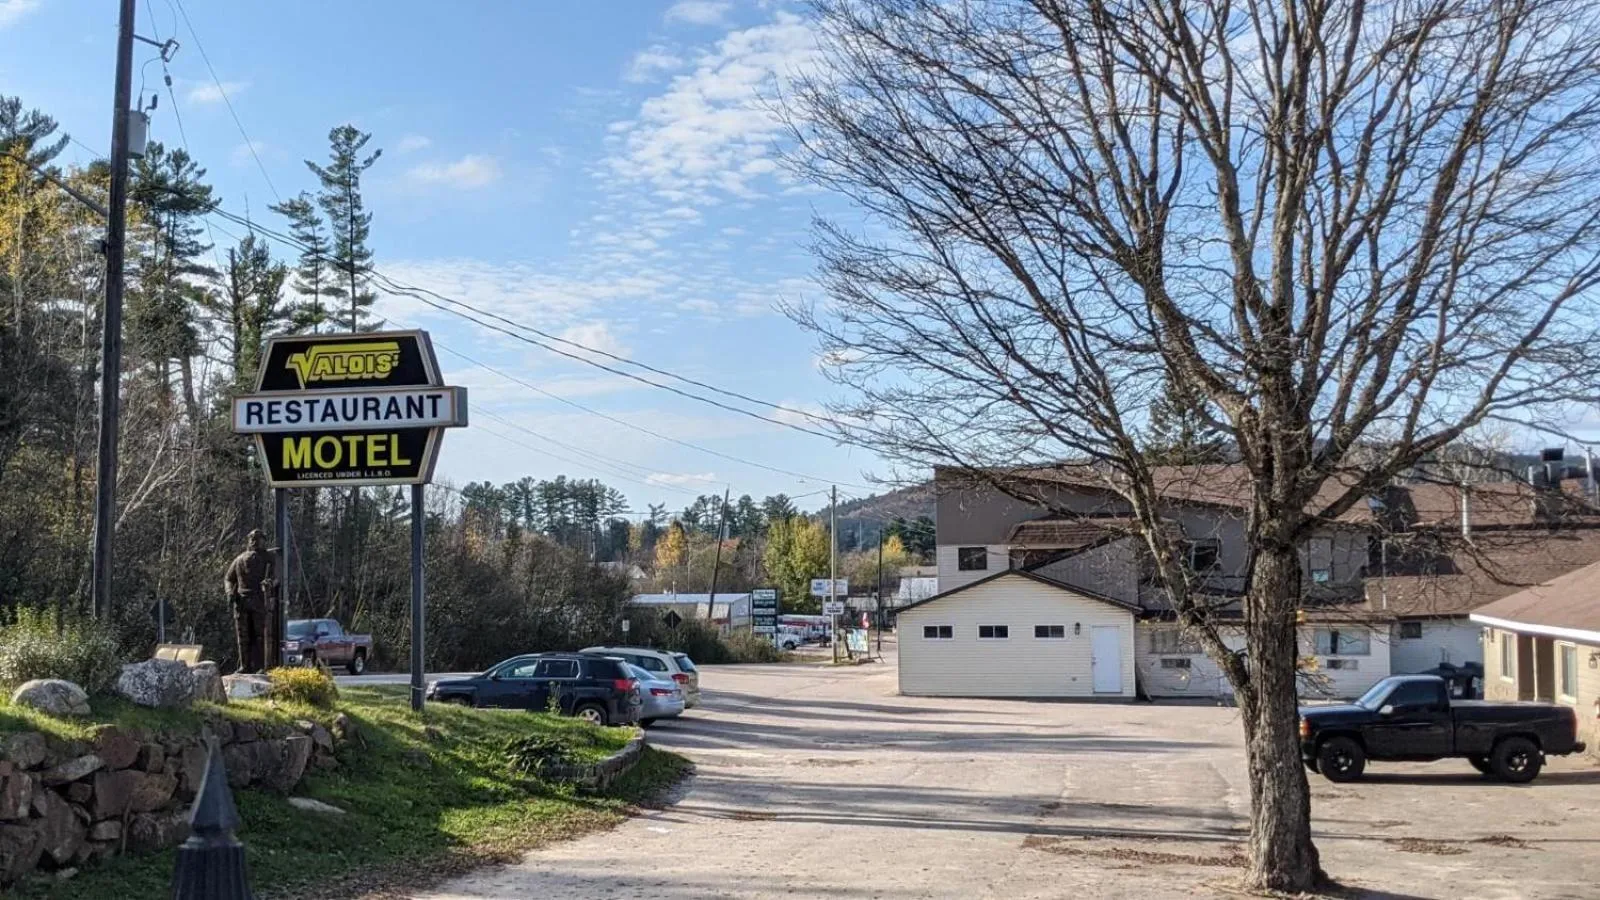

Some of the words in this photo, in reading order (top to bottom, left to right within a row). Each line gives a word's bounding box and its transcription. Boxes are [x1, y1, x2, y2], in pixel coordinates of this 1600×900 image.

[246, 394, 443, 425] RESTAURANT
[282, 433, 412, 469] MOTEL
[335, 471, 361, 479] UNDER
